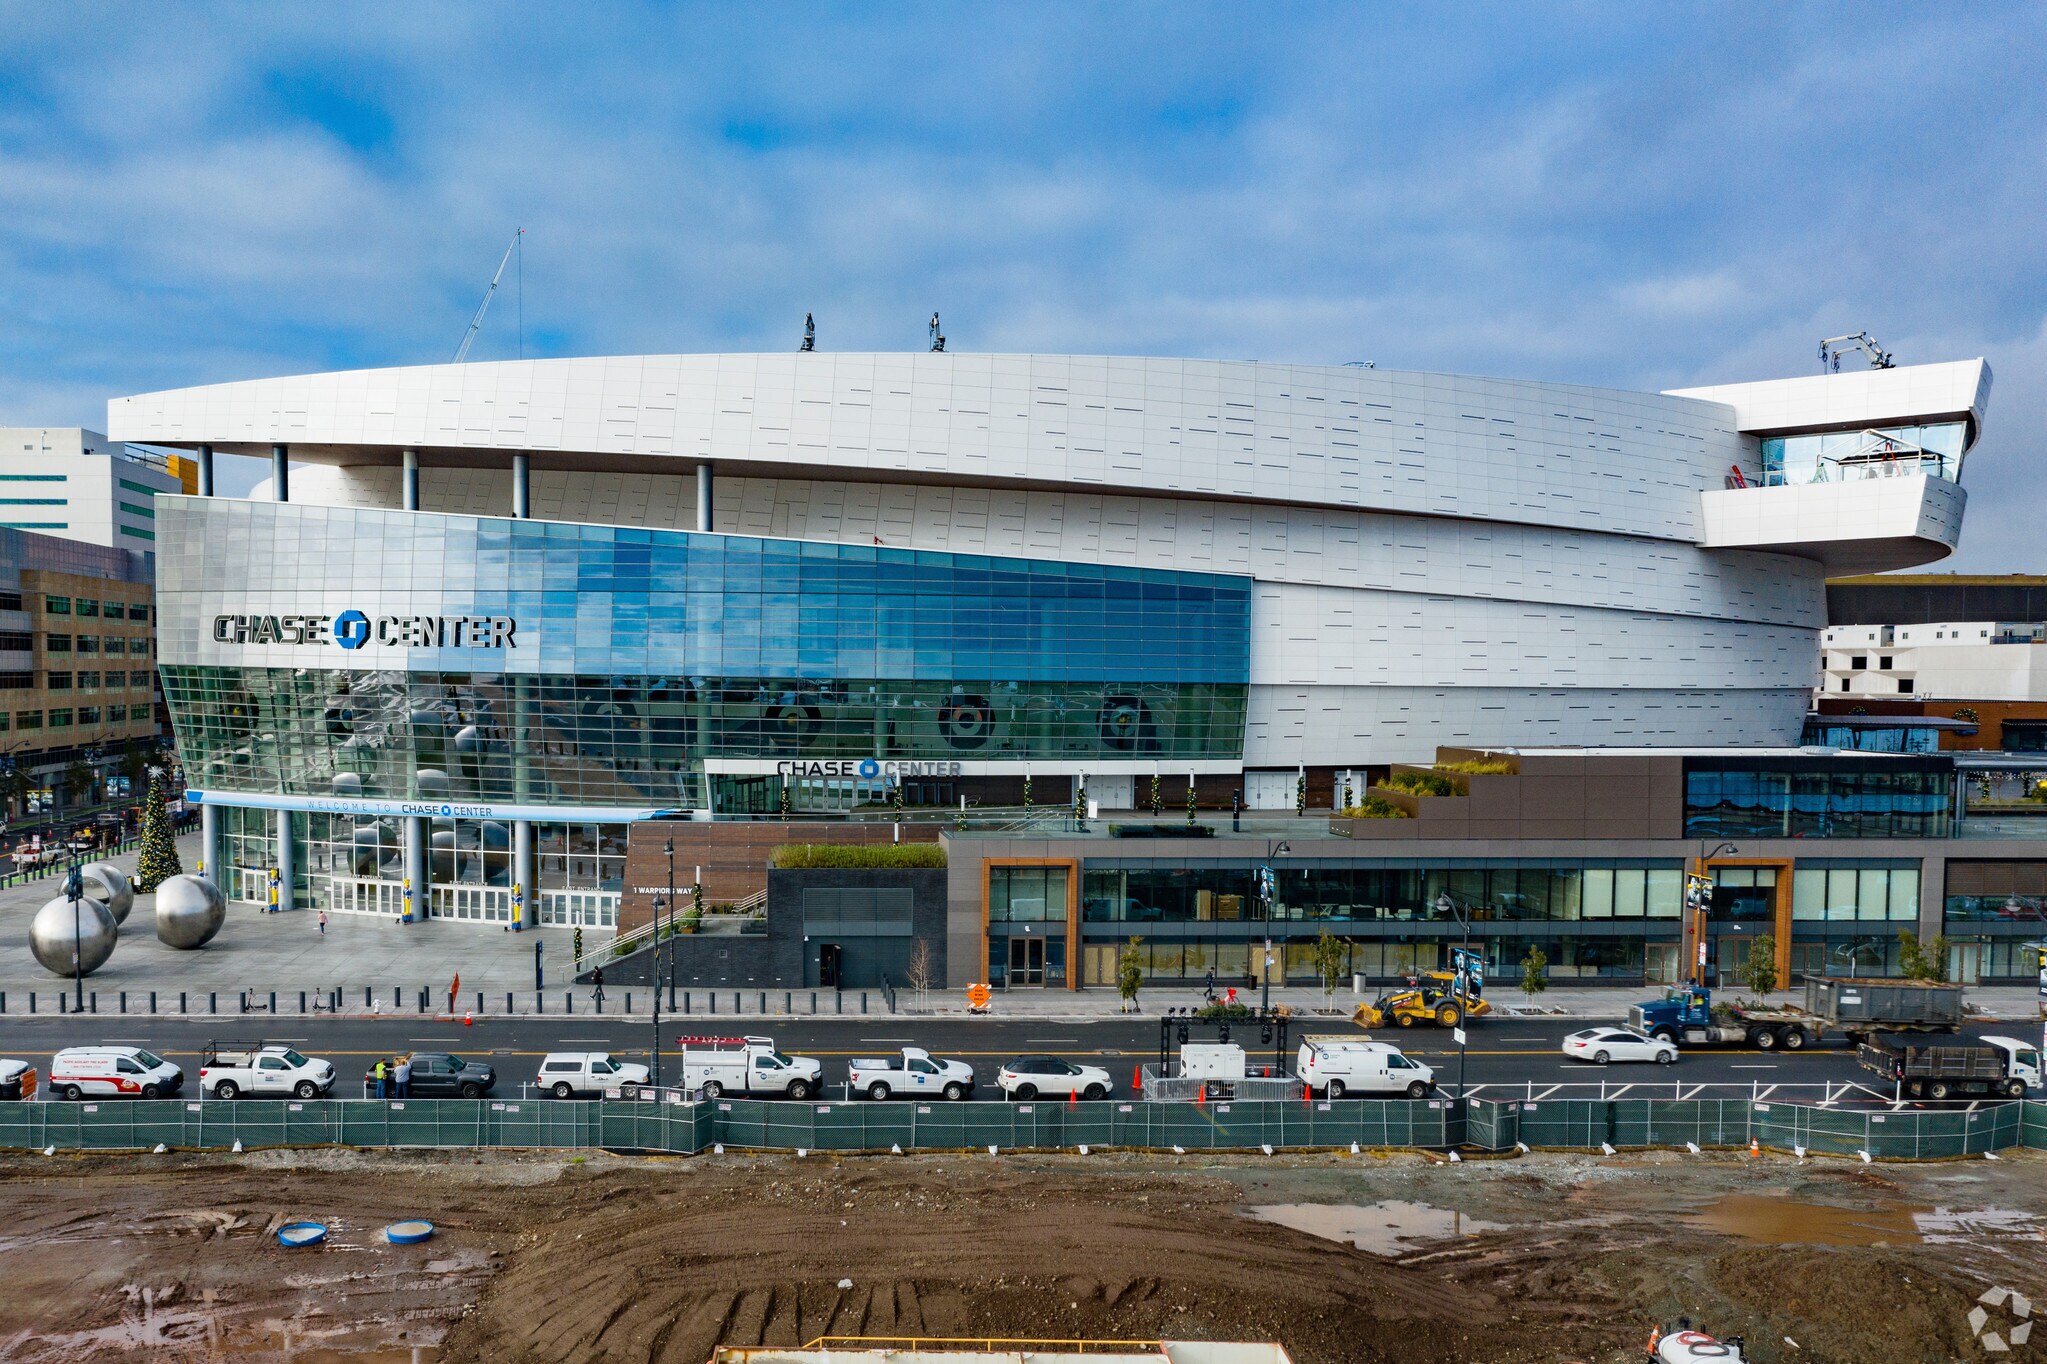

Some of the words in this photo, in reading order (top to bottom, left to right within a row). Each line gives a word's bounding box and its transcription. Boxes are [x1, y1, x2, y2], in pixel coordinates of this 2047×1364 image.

[213, 614, 328, 645] CHASE
[375, 616, 515, 648] CENTER
[777, 761, 855, 776] CHASE
[884, 762, 961, 777] CENTER
[307, 801, 367, 811] WELCOME
[376, 804, 391, 812] TO
[402, 804, 440, 814] CHASE
[453, 806, 493, 816] CENTER
